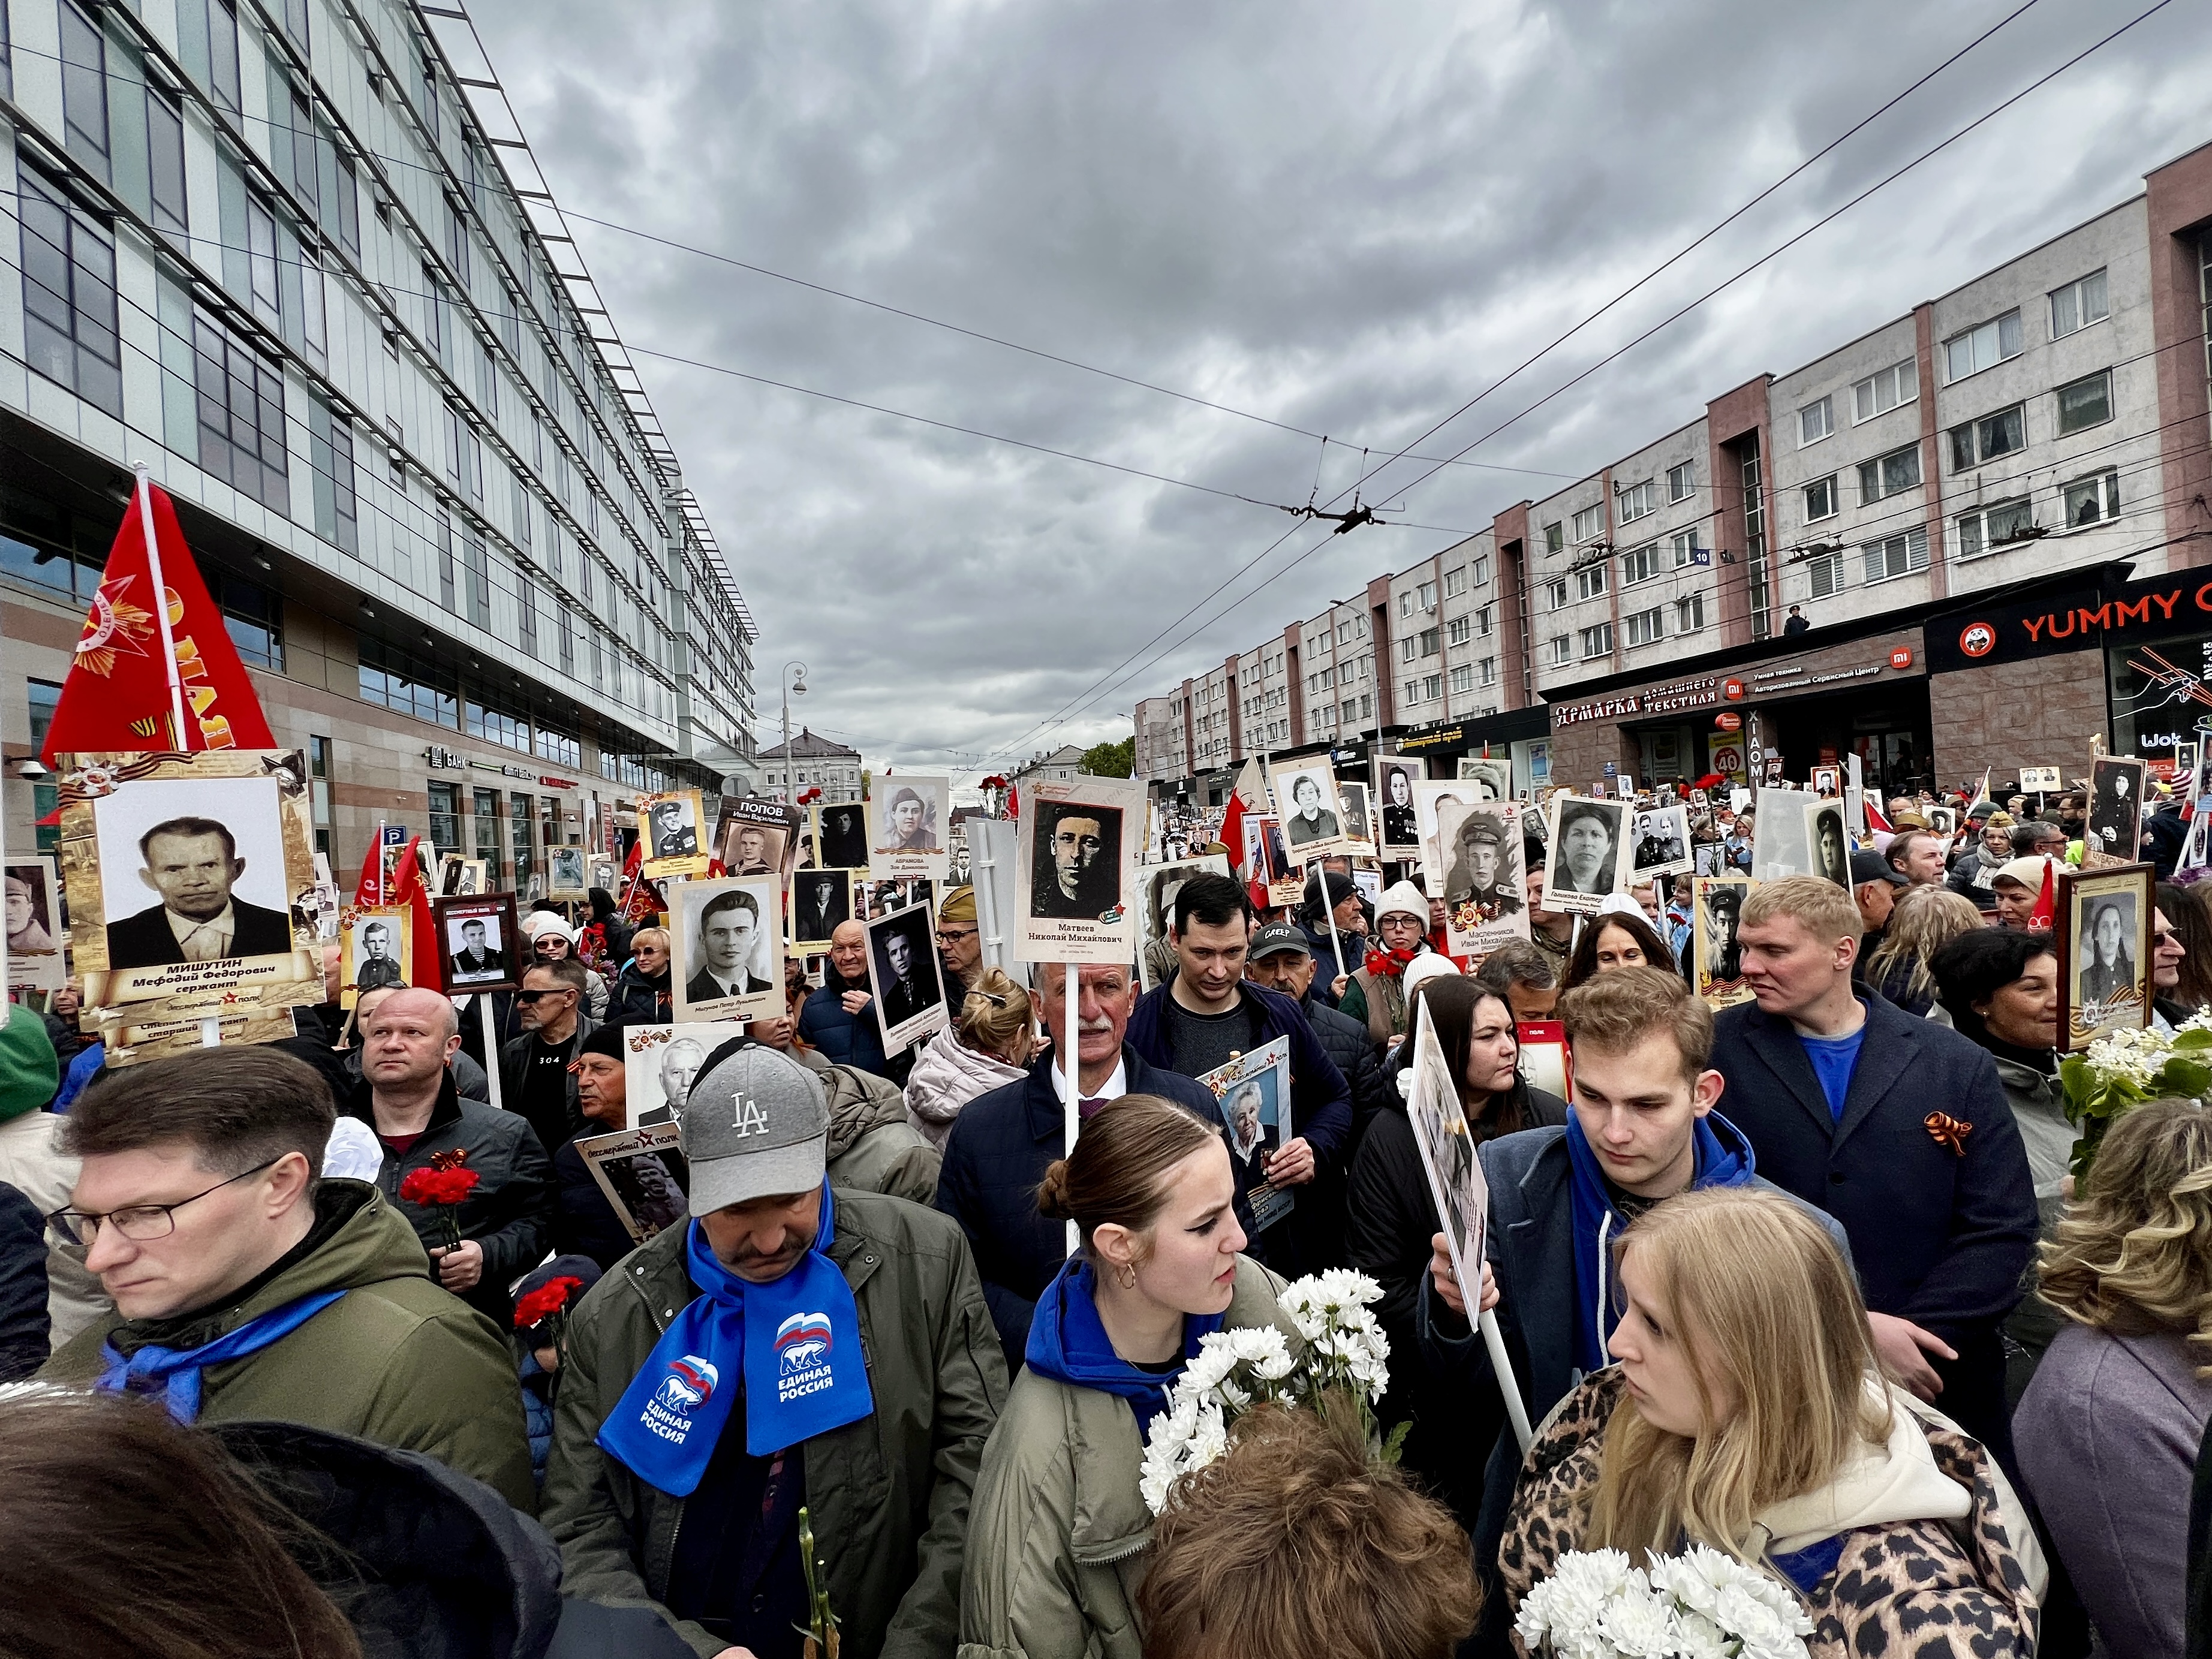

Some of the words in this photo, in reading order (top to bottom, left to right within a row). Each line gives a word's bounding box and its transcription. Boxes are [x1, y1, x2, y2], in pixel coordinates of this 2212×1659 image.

[1696, 553, 1707, 562] 10
[2022, 589, 2182, 642] YUMMY
[1753, 671, 1774, 681] Умная
[1775, 666, 1802, 676] техника
[1754, 678, 1811, 693] Авторизованный
[1812, 670, 1854, 684] Сервисный
[1855, 666, 1880, 677] Центр
[1644, 691, 1716, 713] ТЕКСТИЛЯ
[2141, 733, 2183, 747] Wok
[1748, 710, 1762, 790] XIAOMI
[447, 753, 467, 769] БАНК
[2147, 764, 2172, 773] ДЕСЬ
[733, 810, 750, 819] Иван
[740, 802, 784, 817] ПОПОВ
[389, 833, 400, 844] P
[1579, 894, 1603, 903] Екатер
[1028, 933, 1067, 941] Николай
[1069, 934, 1122, 943] Михайлович
[1468, 928, 1515, 939] Масленников
[1461, 939, 1479, 948] Иван
[166, 959, 242, 974] МИШУТИН
[133, 972, 198, 987] Мефодий
[203, 965, 275, 980] Федорович
[176, 980, 237, 994] сержант
[238, 994, 260, 1004] полк
[148, 1023, 198, 1038] старший
[1275, 1052, 1287, 1062] полк
[730, 1091, 769, 1139] LA
[655, 1133, 679, 1145] полк
[778, 1365, 832, 1391] ЕДИНАЯ
[779, 1376, 833, 1403] РОССИЯ
[646, 1398, 693, 1432] ЕДИНАЯ
[640, 1411, 687, 1445] РОССИЯ
